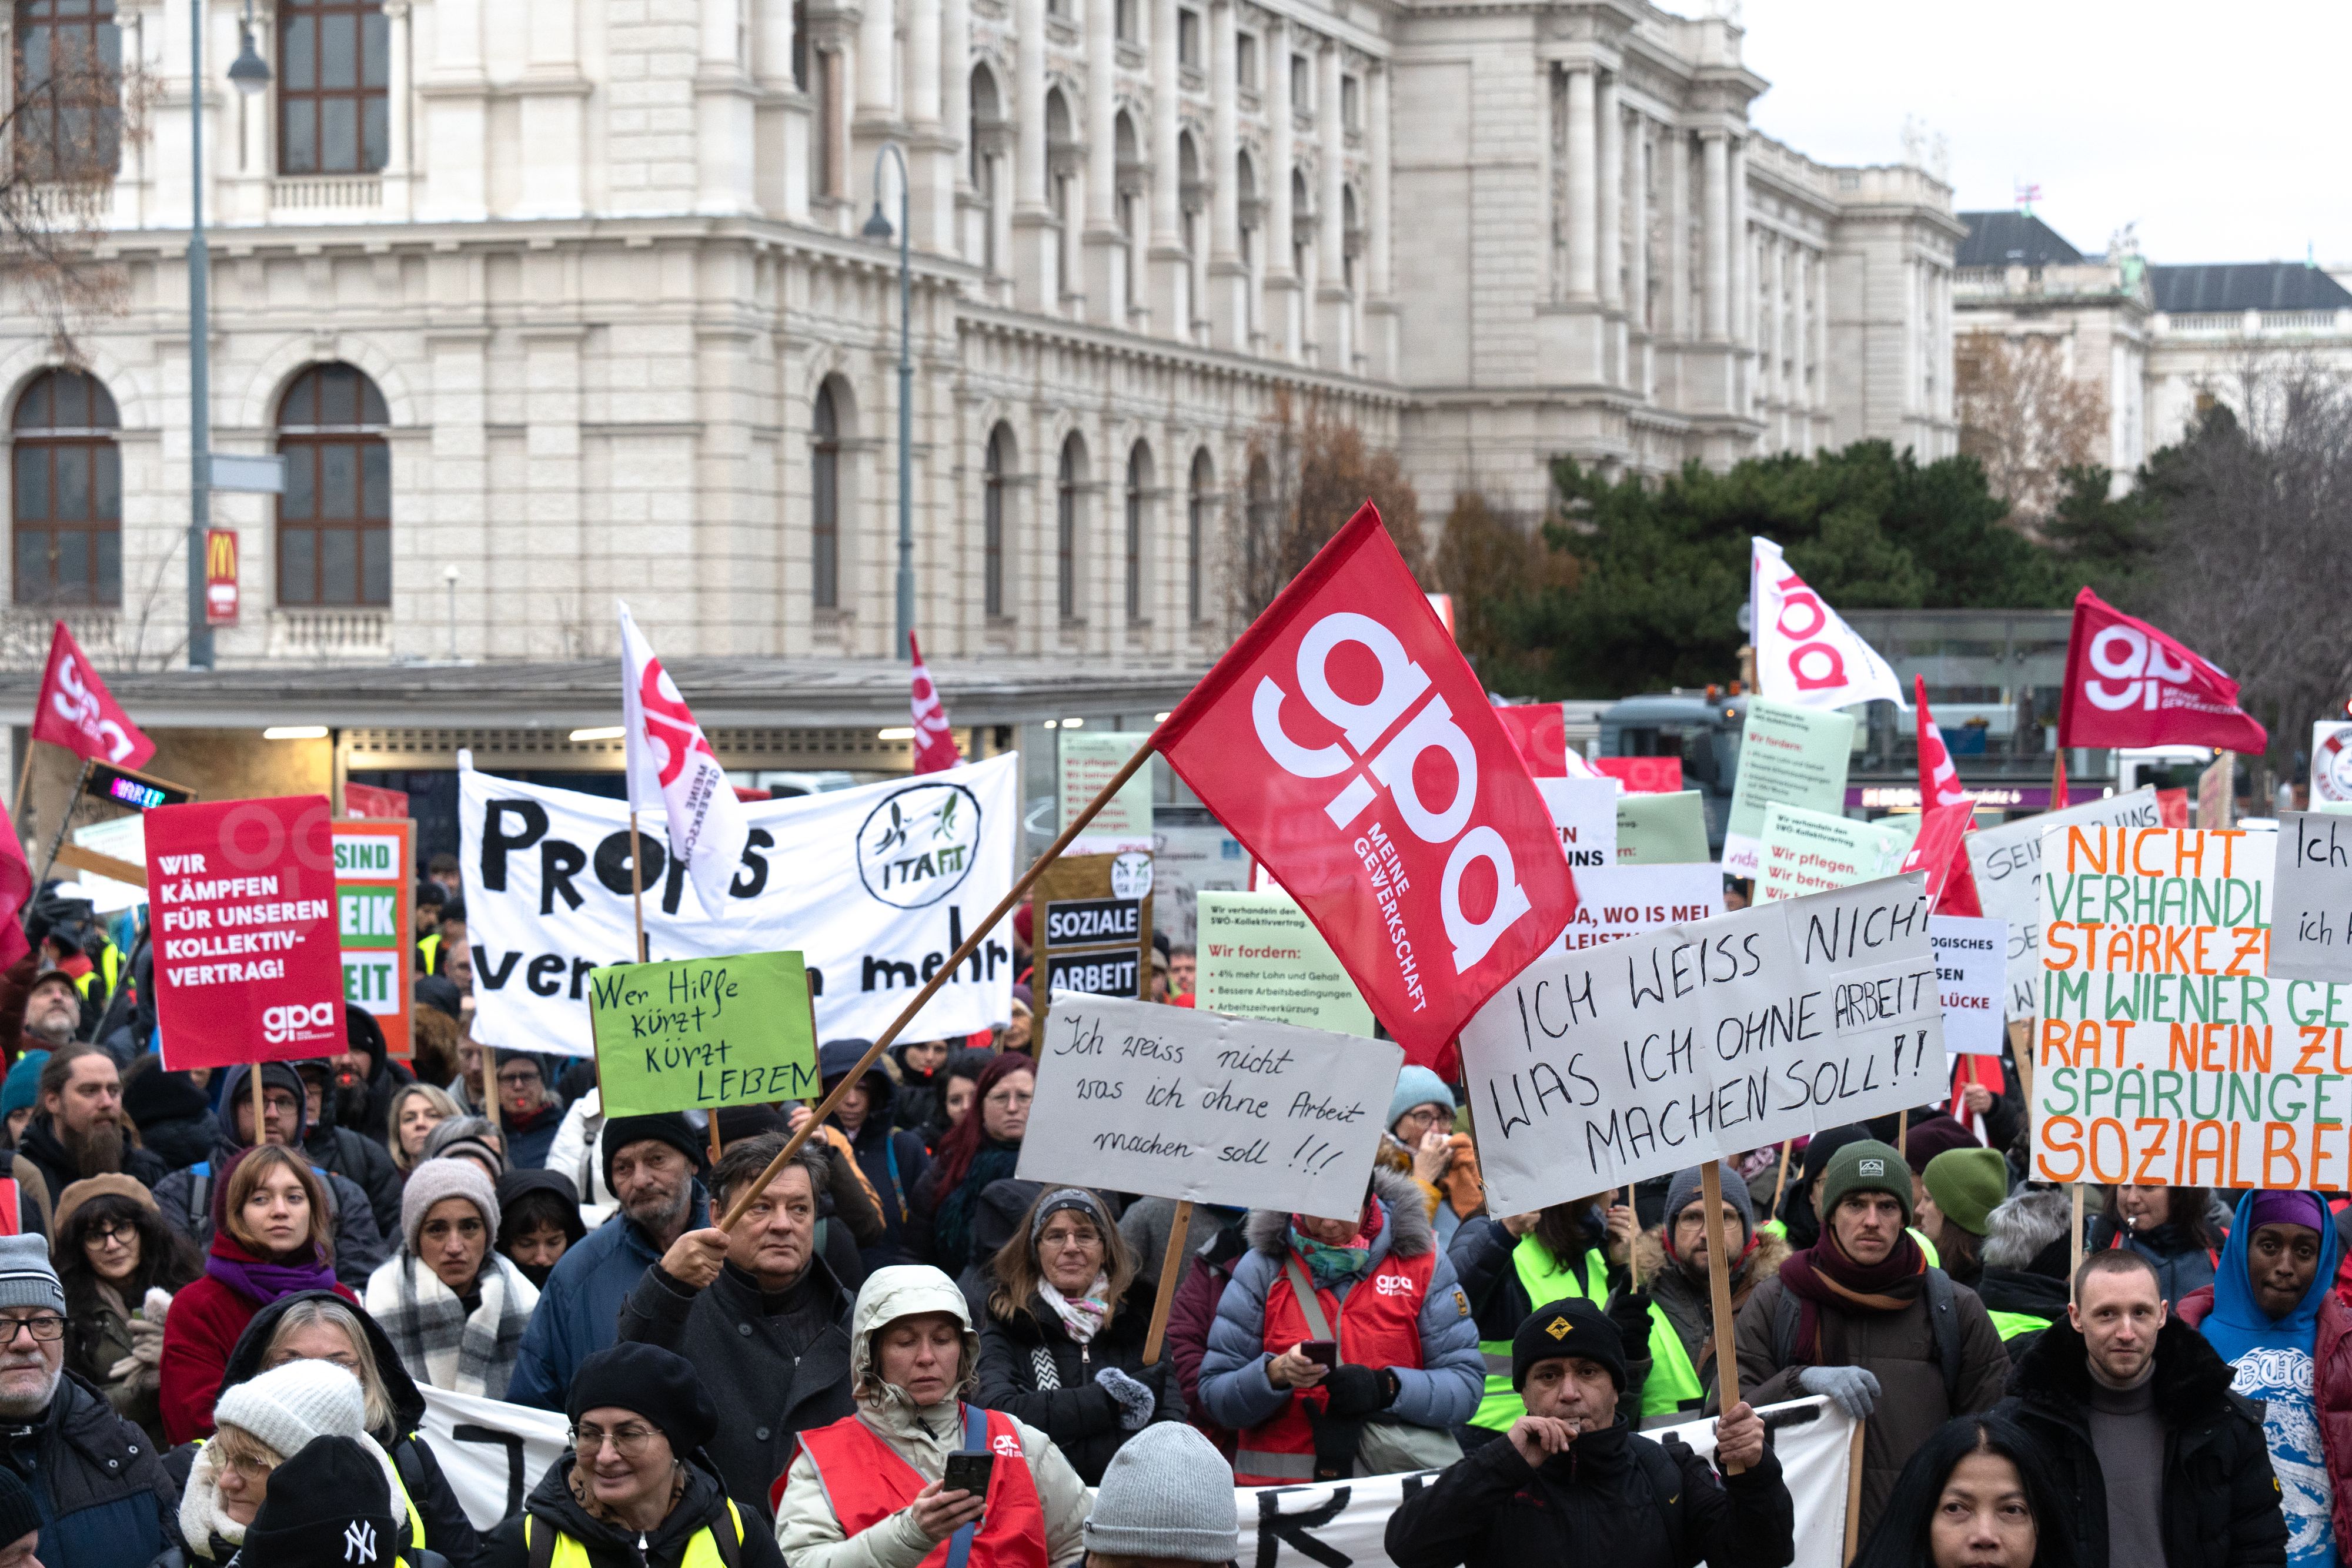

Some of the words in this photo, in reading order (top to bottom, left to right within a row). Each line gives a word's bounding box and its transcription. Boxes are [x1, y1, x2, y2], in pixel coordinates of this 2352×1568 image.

[1252, 612, 1531, 975] gpa
[335, 844, 389, 870] SIND
[1368, 822, 1411, 898] MEINE
[1771, 845, 1796, 858] Wir
[1799, 852, 1857, 875] pflegen.
[2066, 825, 2247, 878] NICHT
[2297, 818, 2348, 868] Ich
[158, 854, 206, 875] WIR
[1768, 865, 1792, 880] Wir
[161, 875, 278, 904] KÄMPFEN
[1211, 905, 1225, 914] Wir
[1228, 906, 1277, 915] verhandeln
[2046, 872, 2271, 929] VERHANDL
[163, 908, 211, 931] FÜR
[217, 899, 329, 925] UNSEREN
[1048, 907, 1138, 938] SOZIALE
[1354, 837, 1428, 1014] GEWERKSCHAFT
[1603, 907, 1639, 923] WO
[1646, 905, 1665, 923] IS
[2299, 911, 2333, 946] ich
[165, 930, 306, 959] KOLLEKTIV-
[861, 906, 1008, 992] mehr
[1208, 944, 1234, 958] Wir
[1238, 945, 1302, 959] fordern:
[2042, 920, 2219, 975] STÄRKE
[166, 959, 285, 988] VERTRAG!
[593, 974, 649, 1009] Wer
[669, 968, 739, 1018] Hilfe
[1049, 961, 1137, 995] ARBEIT
[1218, 987, 1253, 995] Bessere
[1255, 988, 1352, 999] Arbeitsbedingungen
[1235, 971, 1259, 979] mehr
[1262, 972, 1286, 980] Lohn
[1288, 972, 1306, 981] und
[1308, 972, 1340, 981] Gehalt
[1516, 969, 1598, 1052] ICH
[1628, 932, 1762, 1009] WEISS
[1218, 1003, 1319, 1015] Arbeitszeitverkürzung
[2044, 970, 2089, 1021] IM
[2105, 973, 2270, 1026] WIENER
[2287, 979, 2349, 1029] GE
[263, 1002, 334, 1044] gpa
[1054, 1015, 1102, 1056] Ich
[1122, 1035, 1184, 1064] weiss
[1218, 1045, 1294, 1075] nicht
[1489, 1052, 1600, 1139] WAS
[1623, 1026, 1694, 1091] ICH
[1716, 991, 1823, 1061] OHNE
[1833, 971, 1936, 1030] ARBEIT
[2040, 1019, 2144, 1070] RAT.
[2169, 1022, 2272, 1074] NEIN
[697, 1062, 817, 1102] LEBEN
[1077, 1077, 1124, 1100] was
[1146, 1077, 1186, 1109] ich
[1202, 1079, 1268, 1118] ohne
[1287, 1090, 1366, 1124] Arbeit
[2042, 1067, 2352, 1124] SPARUNGE
[1585, 1065, 1770, 1175] MACHEN
[1093, 1132, 1195, 1158] machen
[1218, 1139, 1268, 1164] soll
[2036, 1114, 2352, 1192] SOZIALBE
[1376, 1275, 1413, 1296] gpa
[343, 1519, 377, 1564] NY
